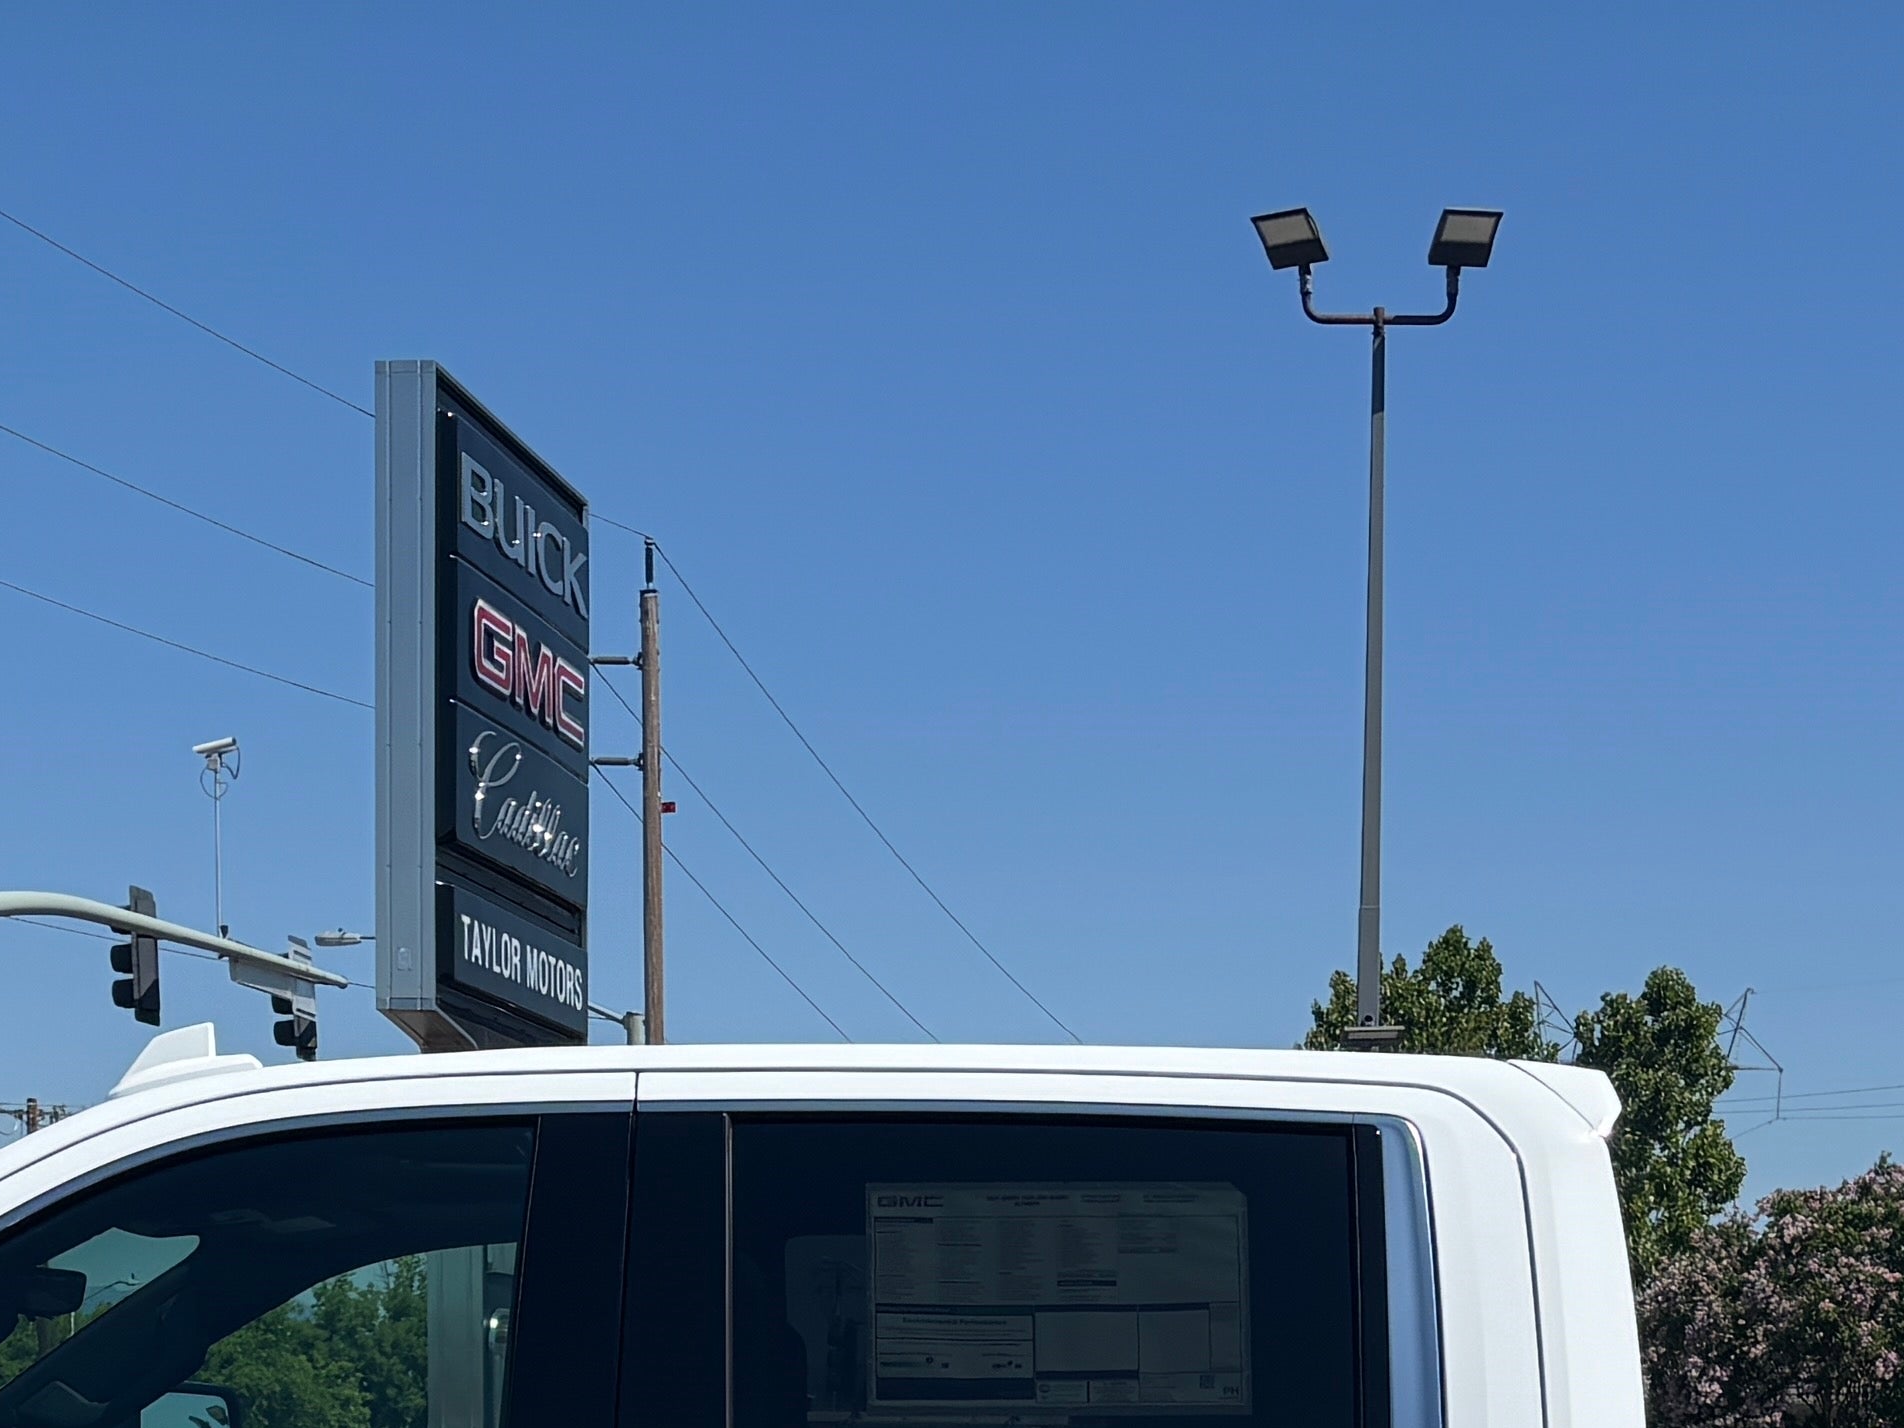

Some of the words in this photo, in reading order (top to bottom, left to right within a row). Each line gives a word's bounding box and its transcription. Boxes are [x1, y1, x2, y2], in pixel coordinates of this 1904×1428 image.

[459, 450, 587, 619] BUICK
[474, 598, 584, 748] GMC
[469, 731, 578, 877] Cadillac
[460, 913, 521, 984] TAYLOR
[526, 944, 583, 1011] MOTORS
[877, 1195, 945, 1208] GMC
